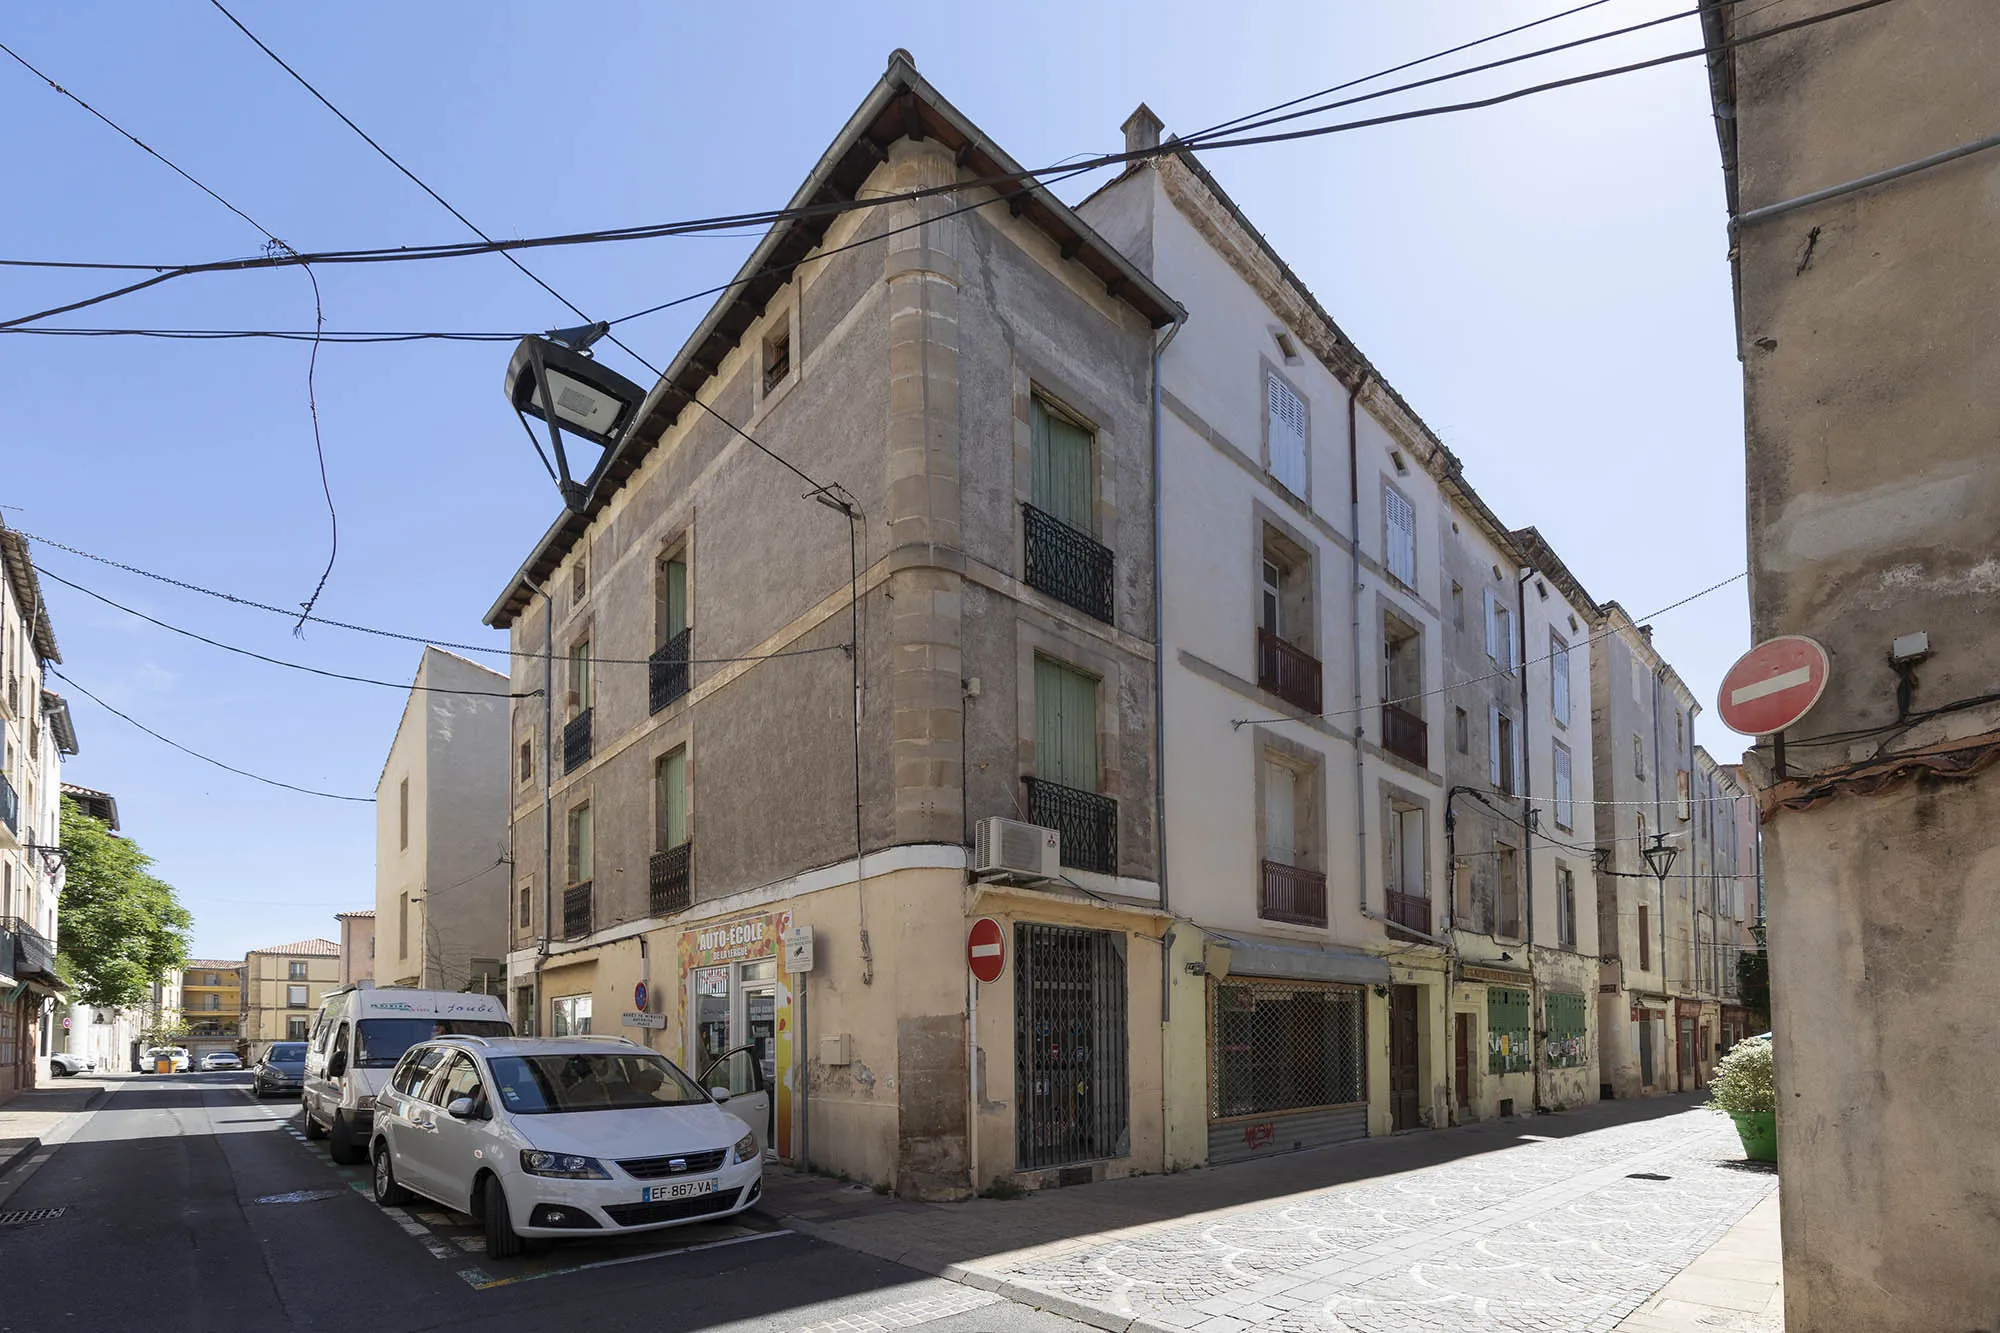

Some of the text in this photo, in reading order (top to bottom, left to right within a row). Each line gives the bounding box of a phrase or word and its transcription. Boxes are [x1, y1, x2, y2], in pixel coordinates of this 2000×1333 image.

[699, 922, 763, 951] AUTO-ÉCOLE
[713, 950, 720, 960] DE
[720, 949, 727, 960] LA
[652, 1181, 712, 1200] EF-867-VA
